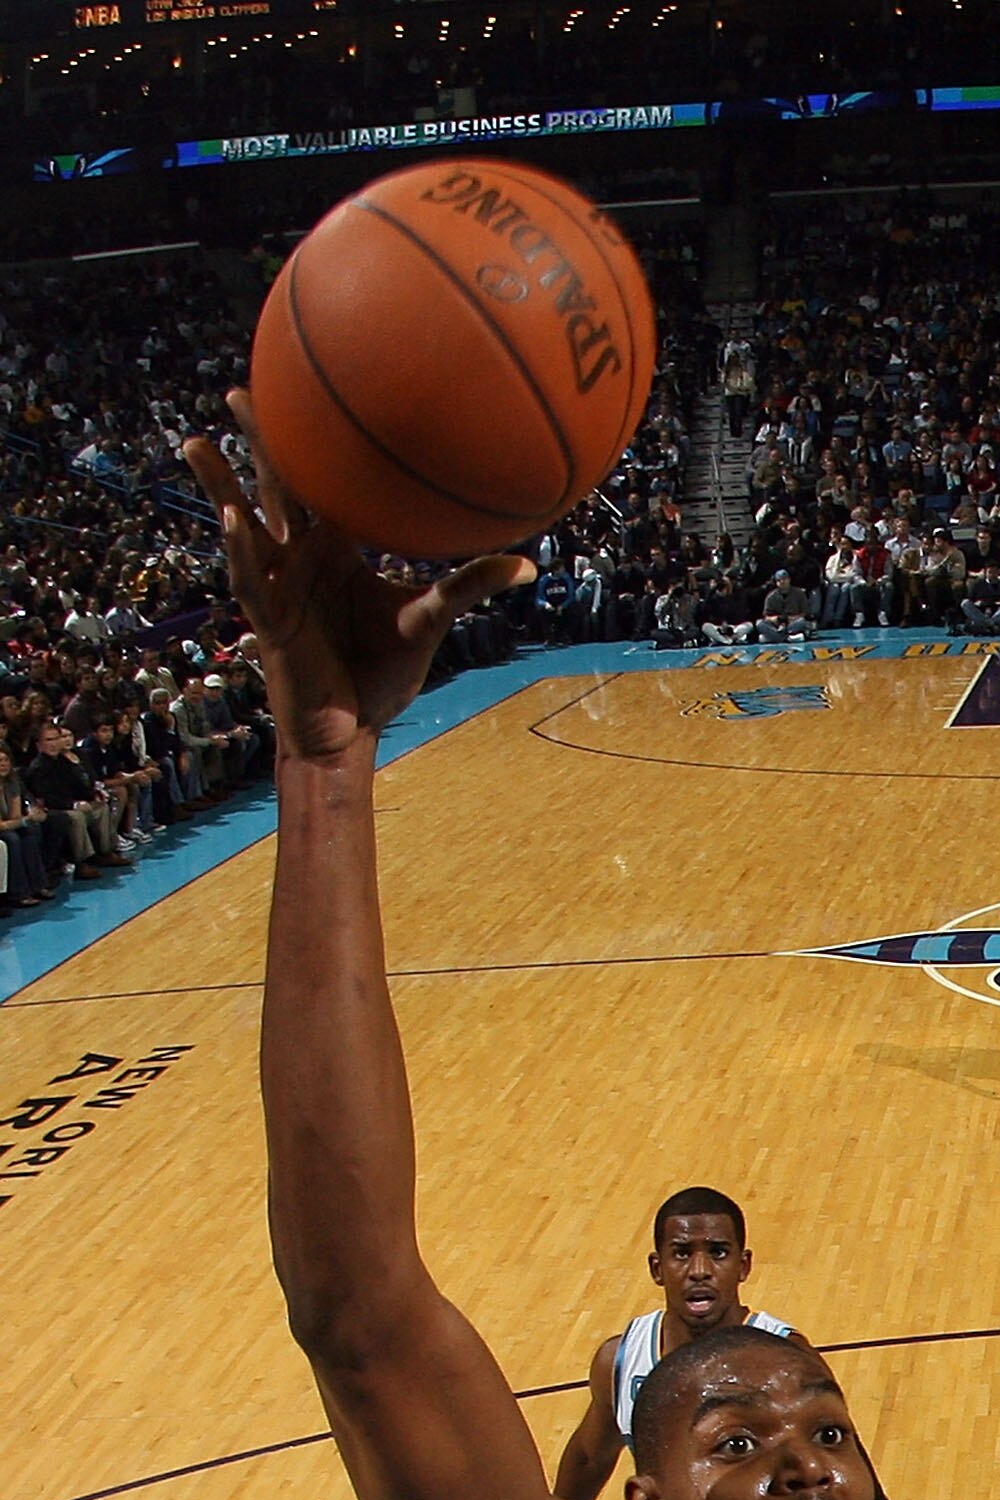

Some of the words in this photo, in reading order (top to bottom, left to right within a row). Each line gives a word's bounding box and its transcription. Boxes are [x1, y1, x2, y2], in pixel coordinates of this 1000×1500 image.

[222, 133, 290, 160] MOST
[294, 124, 417, 153] VALUABLE
[423, 113, 541, 142] BUSINESS
[546, 105, 672, 131] PROGRAM
[420, 169, 623, 396] SPALDING
[692, 645, 880, 669] NEW
[81, 1044, 197, 1110] NEW
